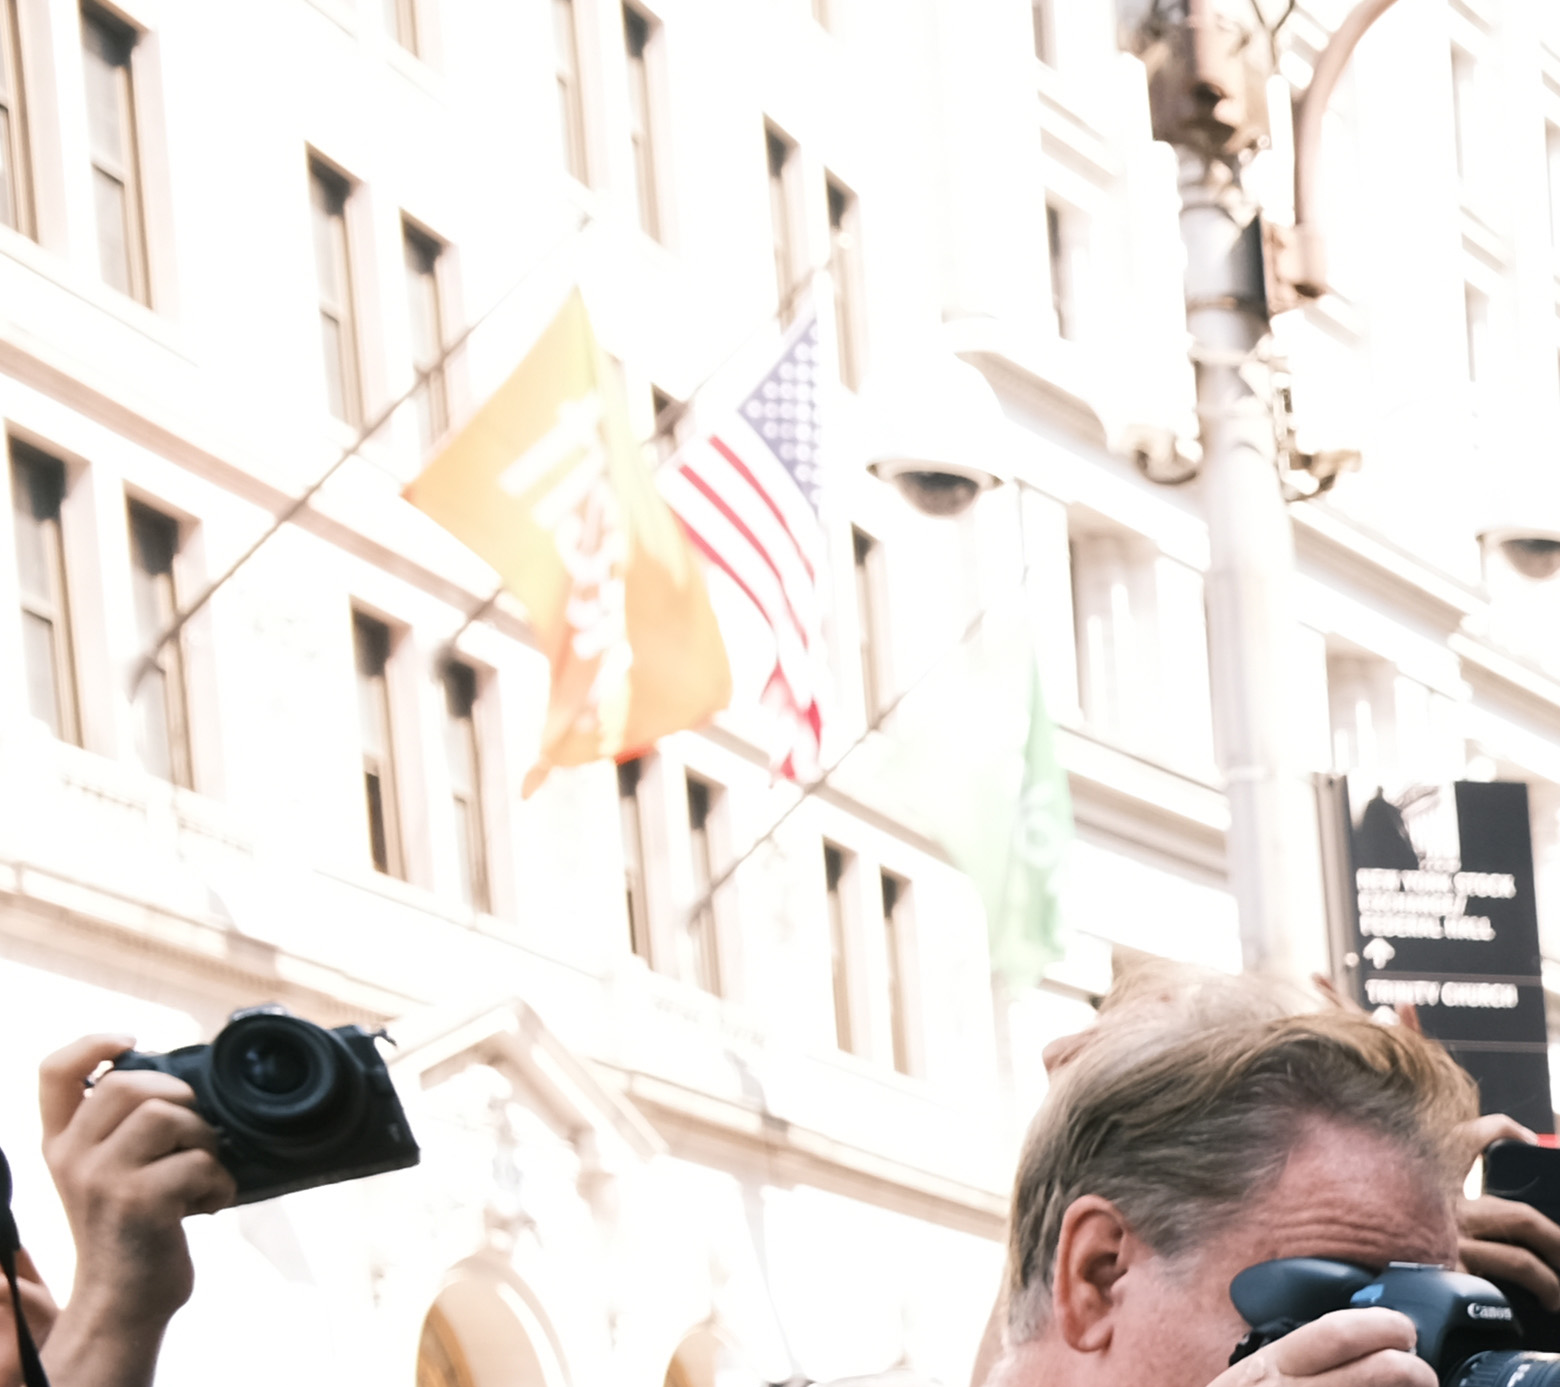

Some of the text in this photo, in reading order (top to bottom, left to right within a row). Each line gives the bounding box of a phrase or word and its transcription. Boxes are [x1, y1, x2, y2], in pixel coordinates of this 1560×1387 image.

[1365, 979, 1518, 1007] TRINITY CHURCH
[1466, 1301, 1510, 1319] Canon
